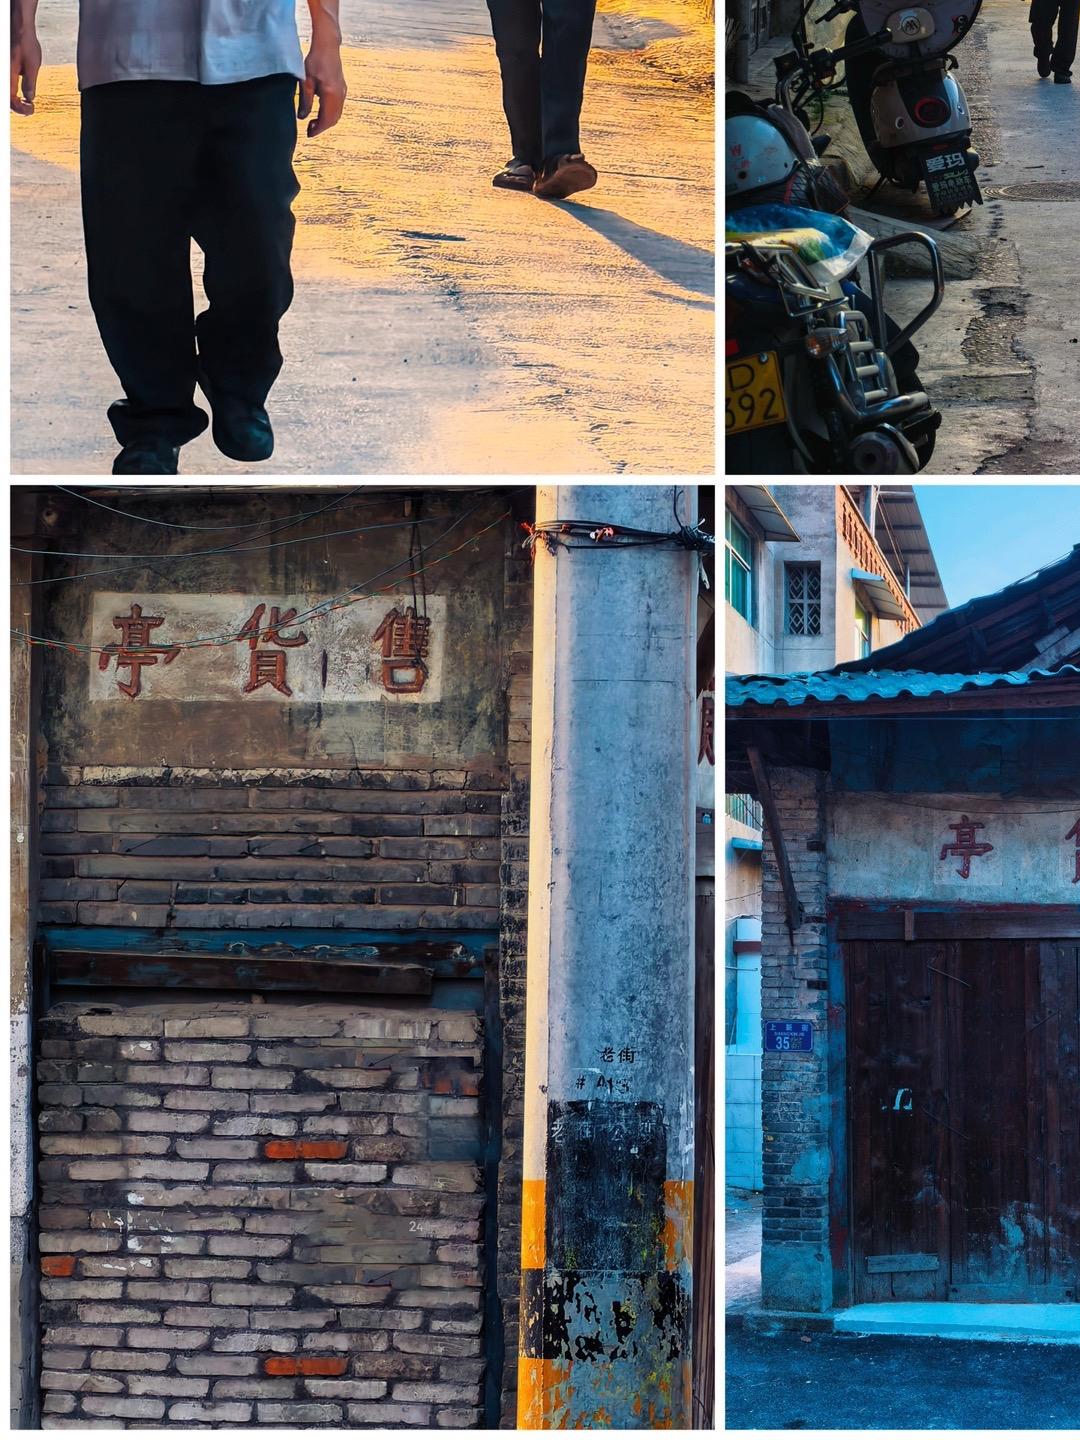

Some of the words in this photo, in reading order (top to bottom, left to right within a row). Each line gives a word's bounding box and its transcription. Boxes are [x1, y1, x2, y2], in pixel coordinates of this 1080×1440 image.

[925, 152, 966, 174] 爱玛
[727, 363, 755, 392] D
[775, 1036, 790, 1050] 35
[408, 1220, 424, 1232] 24
